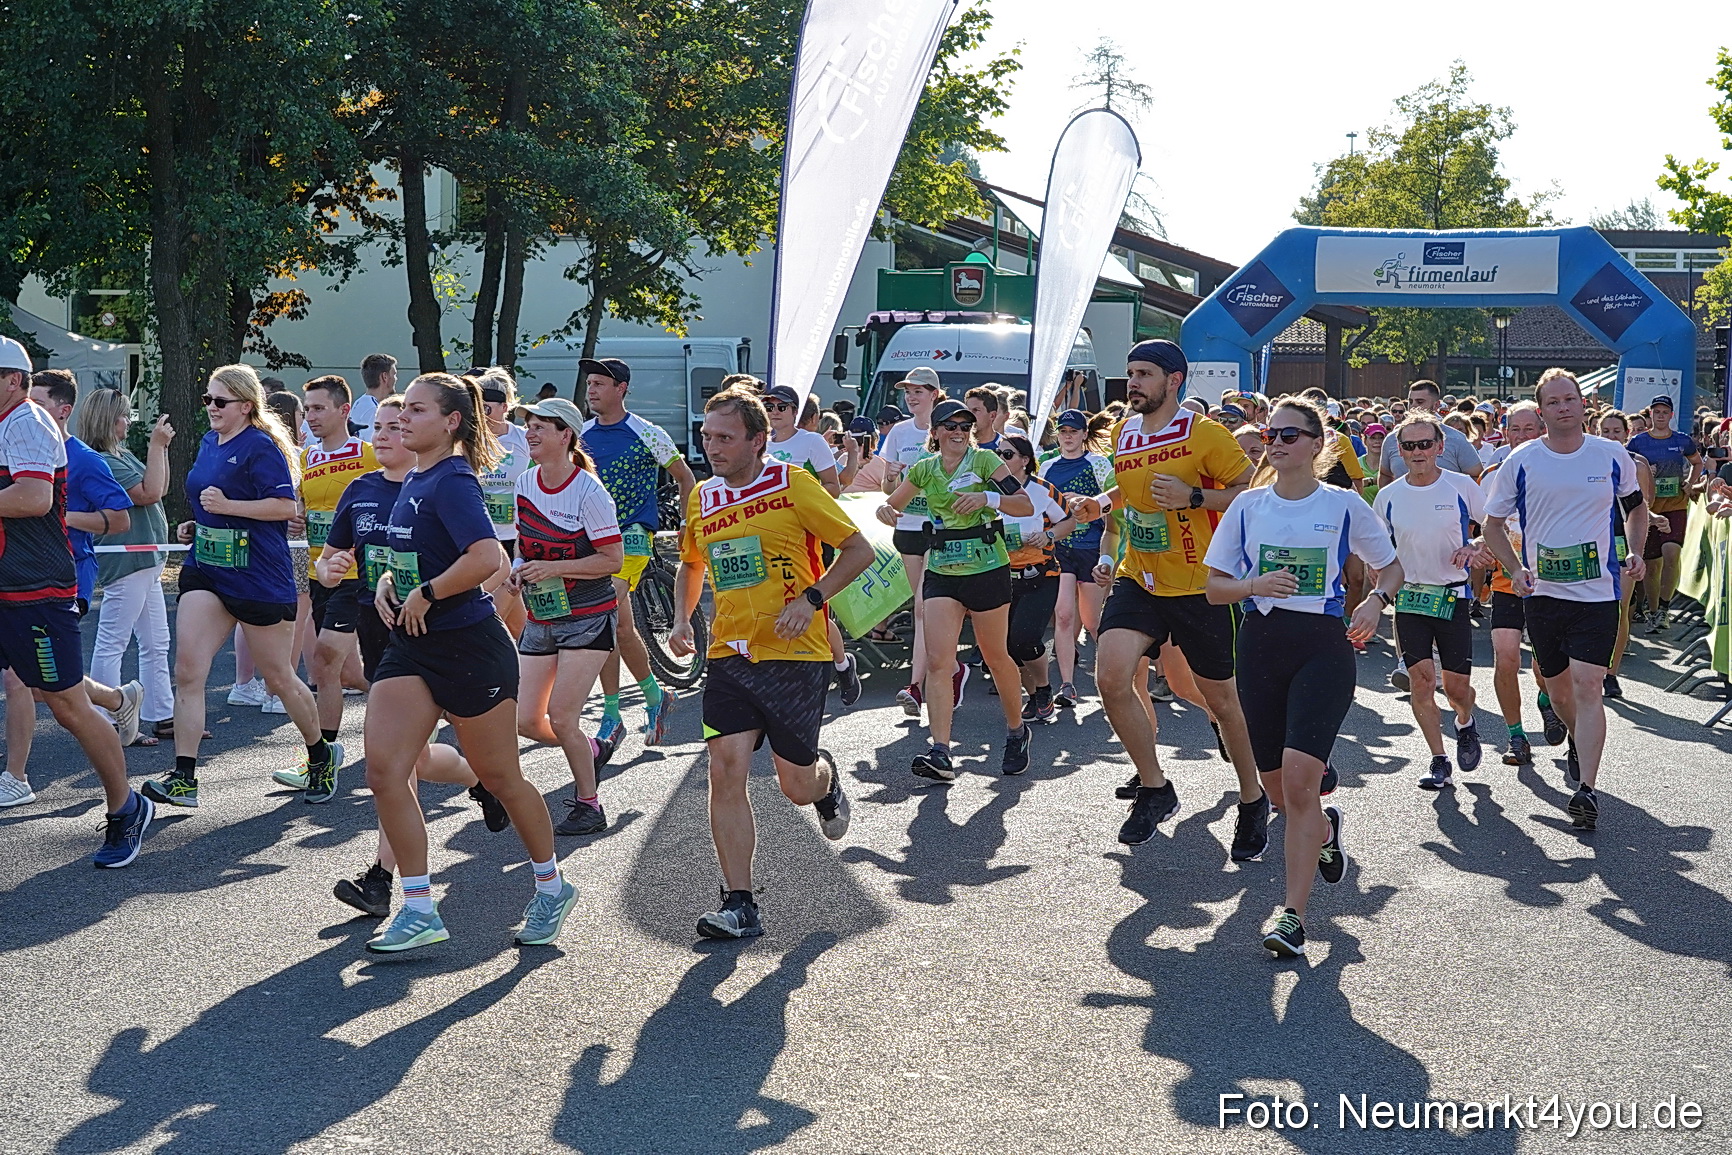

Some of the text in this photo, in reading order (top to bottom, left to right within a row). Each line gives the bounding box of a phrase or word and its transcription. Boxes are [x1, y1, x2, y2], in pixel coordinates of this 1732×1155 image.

[840, 0, 905, 116] Fische
[874, 0, 924, 109] AUTOMOBIL
[1408, 265, 1499, 283] firmenlauf
[794, 196, 870, 390] ww.fischer-automobile.de
[1408, 282, 1446, 290] neumarkt
[1236, 292, 1284, 303] Fischer
[890, 349, 931, 360] abavent
[1115, 445, 1192, 475] MAX BÖGL
[303, 461, 364, 482] MAX BÖGL
[1660, 483, 1674, 491] 648
[703, 495, 795, 537] MAX BÖGL
[624, 534, 645, 546] 687
[1131, 527, 1155, 541] 805
[1159, 527, 1168, 546] 2022
[1176, 508, 1198, 565] maxF
[203, 541, 216, 554] 41
[721, 555, 750, 575] 985
[754, 555, 766, 578] 2022
[887, 557, 904, 579] neum
[1546, 559, 1571, 572] 319
[719, 570, 758, 583] Schmid Michael
[1316, 567, 1324, 589] 2022
[534, 592, 555, 608] 164
[558, 591, 568, 611] 2022
[1407, 591, 1431, 605] 315
[1432, 597, 1441, 613] 2022
[34, 636, 60, 683] PUMA
